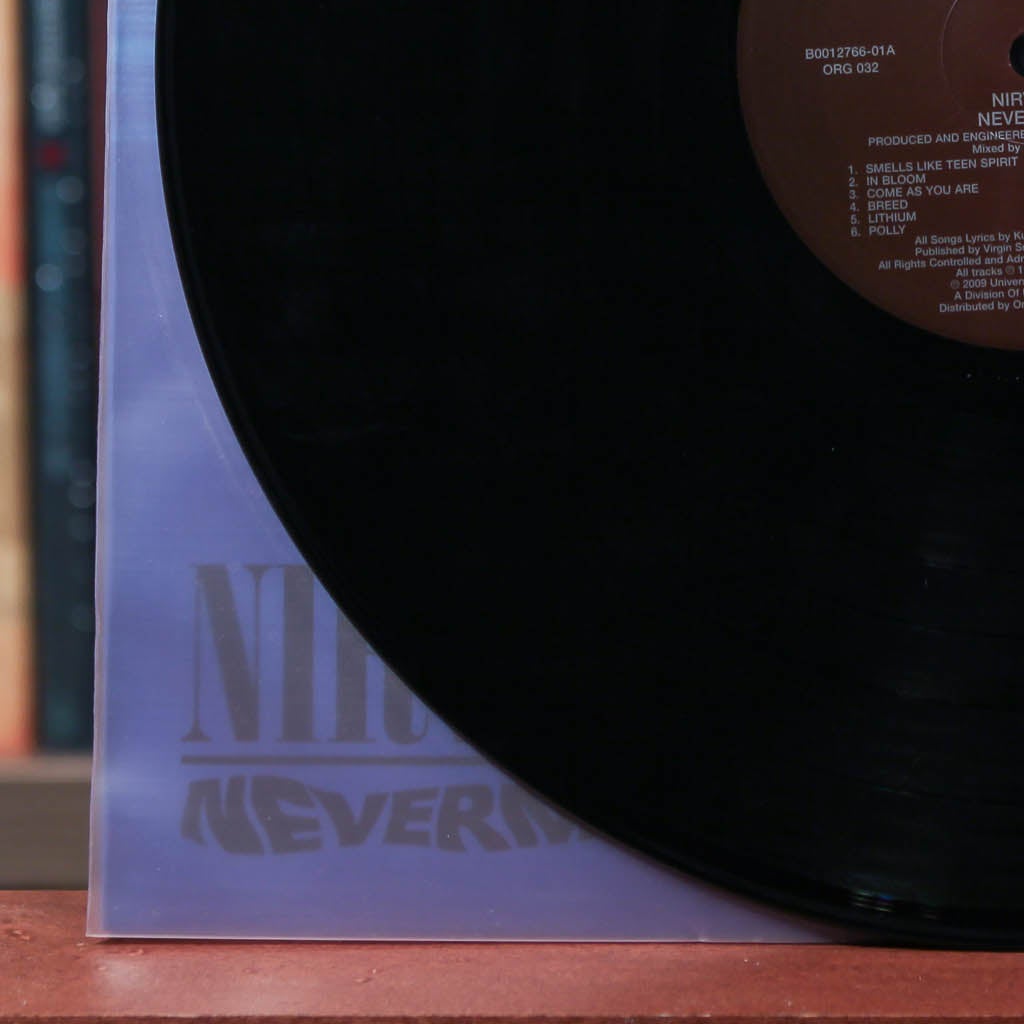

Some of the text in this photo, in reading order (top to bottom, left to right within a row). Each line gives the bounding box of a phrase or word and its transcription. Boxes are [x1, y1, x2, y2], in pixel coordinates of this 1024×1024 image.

[806, 45, 895, 59] B0012766-01A
[823, 62, 879, 75] ORG 032
[868, 134, 932, 146] PRODUCED
[936, 133, 959, 143] AND
[972, 144, 1004, 154] Mixed
[1008, 144, 1020, 153] by
[866, 161, 913, 174] SMELLS
[917, 160, 942, 171] LIKE
[946, 159, 977, 170] TEEN
[980, 156, 1018, 168] SPIRIT
[867, 176, 878, 186] IN
[882, 174, 926, 185] BLOOM
[867, 187, 902, 198] COME
[906, 187, 922, 197] AS
[926, 185, 951, 195] YOU
[954, 184, 979, 194] ARE
[868, 200, 908, 211] BREED
[868, 212, 917, 224] LITHIUM
[869, 225, 906, 236] POLLY
[915, 236, 927, 245] All
[930, 235, 962, 246] Songs
[966, 233, 995, 243] Lyrics
[999, 232, 1010, 242] by
[915, 246, 965, 256] Published
[968, 245, 980, 255] by
[983, 244, 1011, 254] Virgin
[879, 261, 891, 270] All
[894, 259, 926, 270] Rights
[930, 257, 981, 268] Controlled
[985, 256, 1003, 264] and
[956, 268, 968, 277] All
[972, 266, 1002, 276] tracks
[963, 279, 987, 288] 2009
[954, 292, 962, 300] A
[965, 290, 1004, 300] Division
[1008, 289, 1019, 297] Of
[939, 301, 994, 312] Distributed
[998, 300, 1010, 311] by
